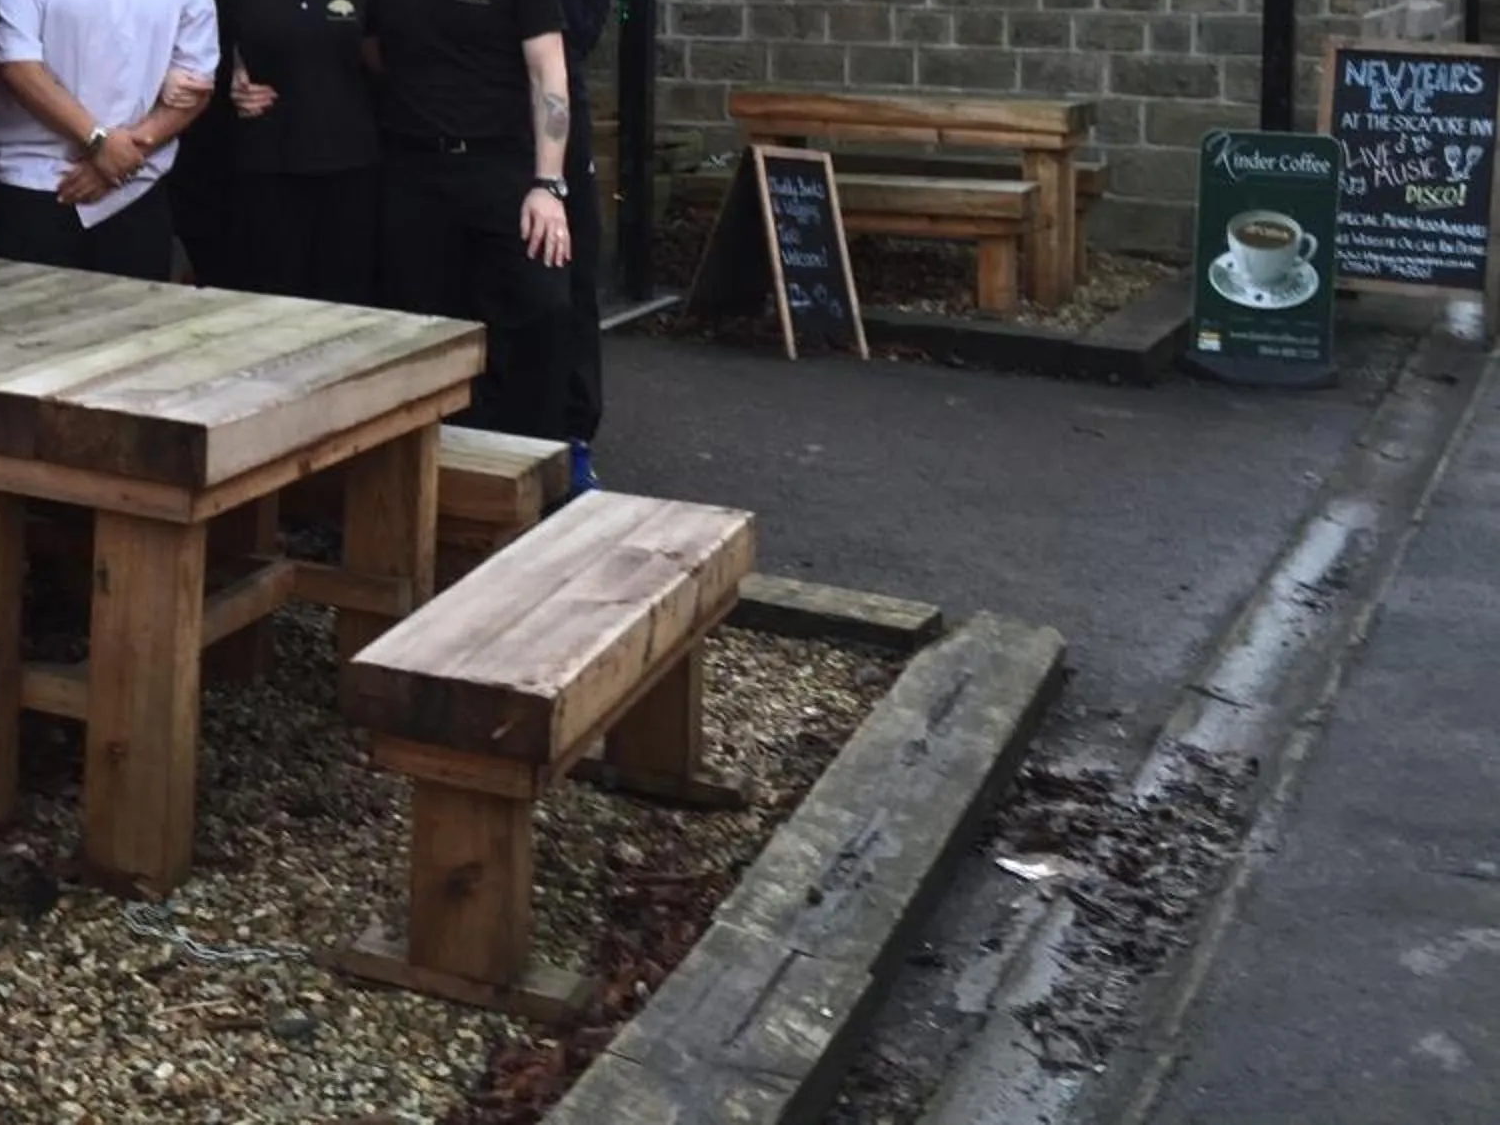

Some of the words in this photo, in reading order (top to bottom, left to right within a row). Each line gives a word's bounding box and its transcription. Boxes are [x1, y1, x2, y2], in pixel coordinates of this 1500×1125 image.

[1344, 59, 1406, 88] NEW
[1369, 83, 1433, 113] EVE
[1341, 112, 1360, 130] AT
[1365, 113, 1390, 131] THE
[1469, 118, 1493, 136] INN
[1206, 129, 1275, 186] Kinder
[1278, 151, 1331, 174] Coffee
[1342, 139, 1391, 169] LIVE
[1373, 156, 1438, 188] MUSIC
[1405, 183, 1467, 206] DISCO!
